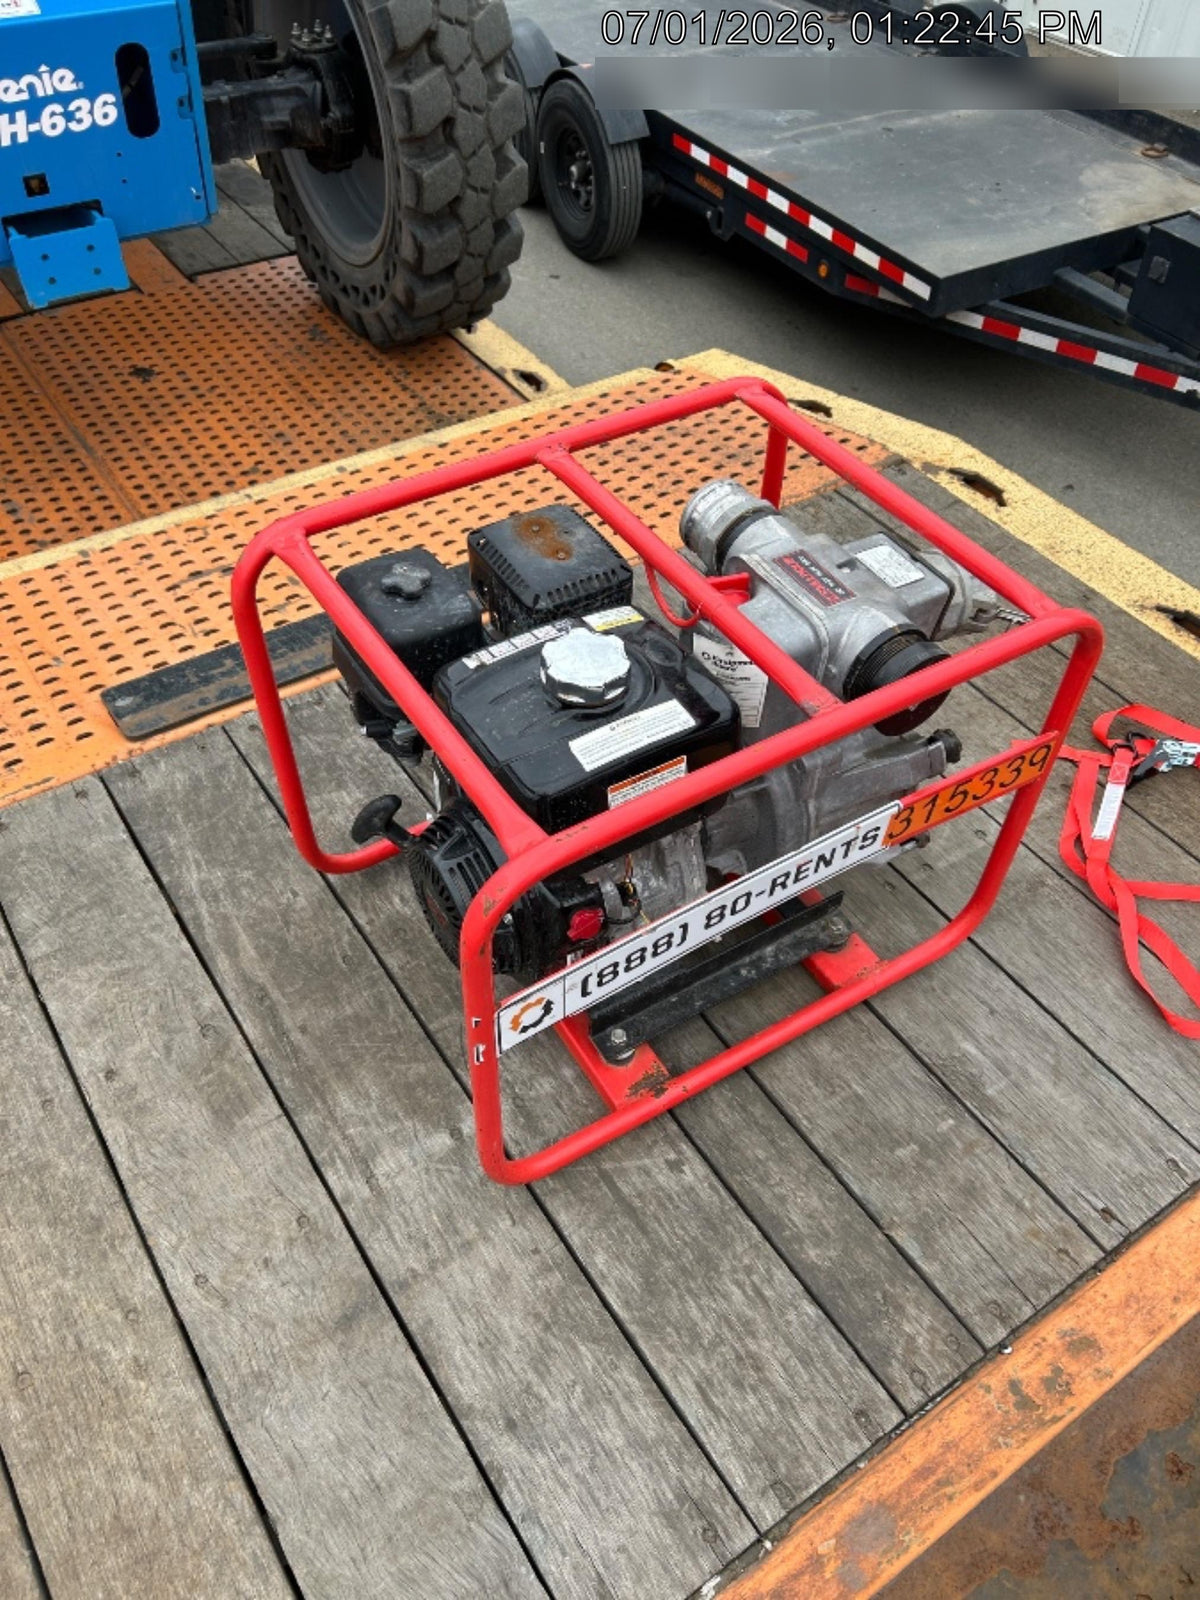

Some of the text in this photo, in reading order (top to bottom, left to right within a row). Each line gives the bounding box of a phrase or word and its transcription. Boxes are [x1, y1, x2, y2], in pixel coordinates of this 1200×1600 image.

[889, 744, 1052, 839] 315339
[580, 826, 881, 998] (888) 80-RENTS
